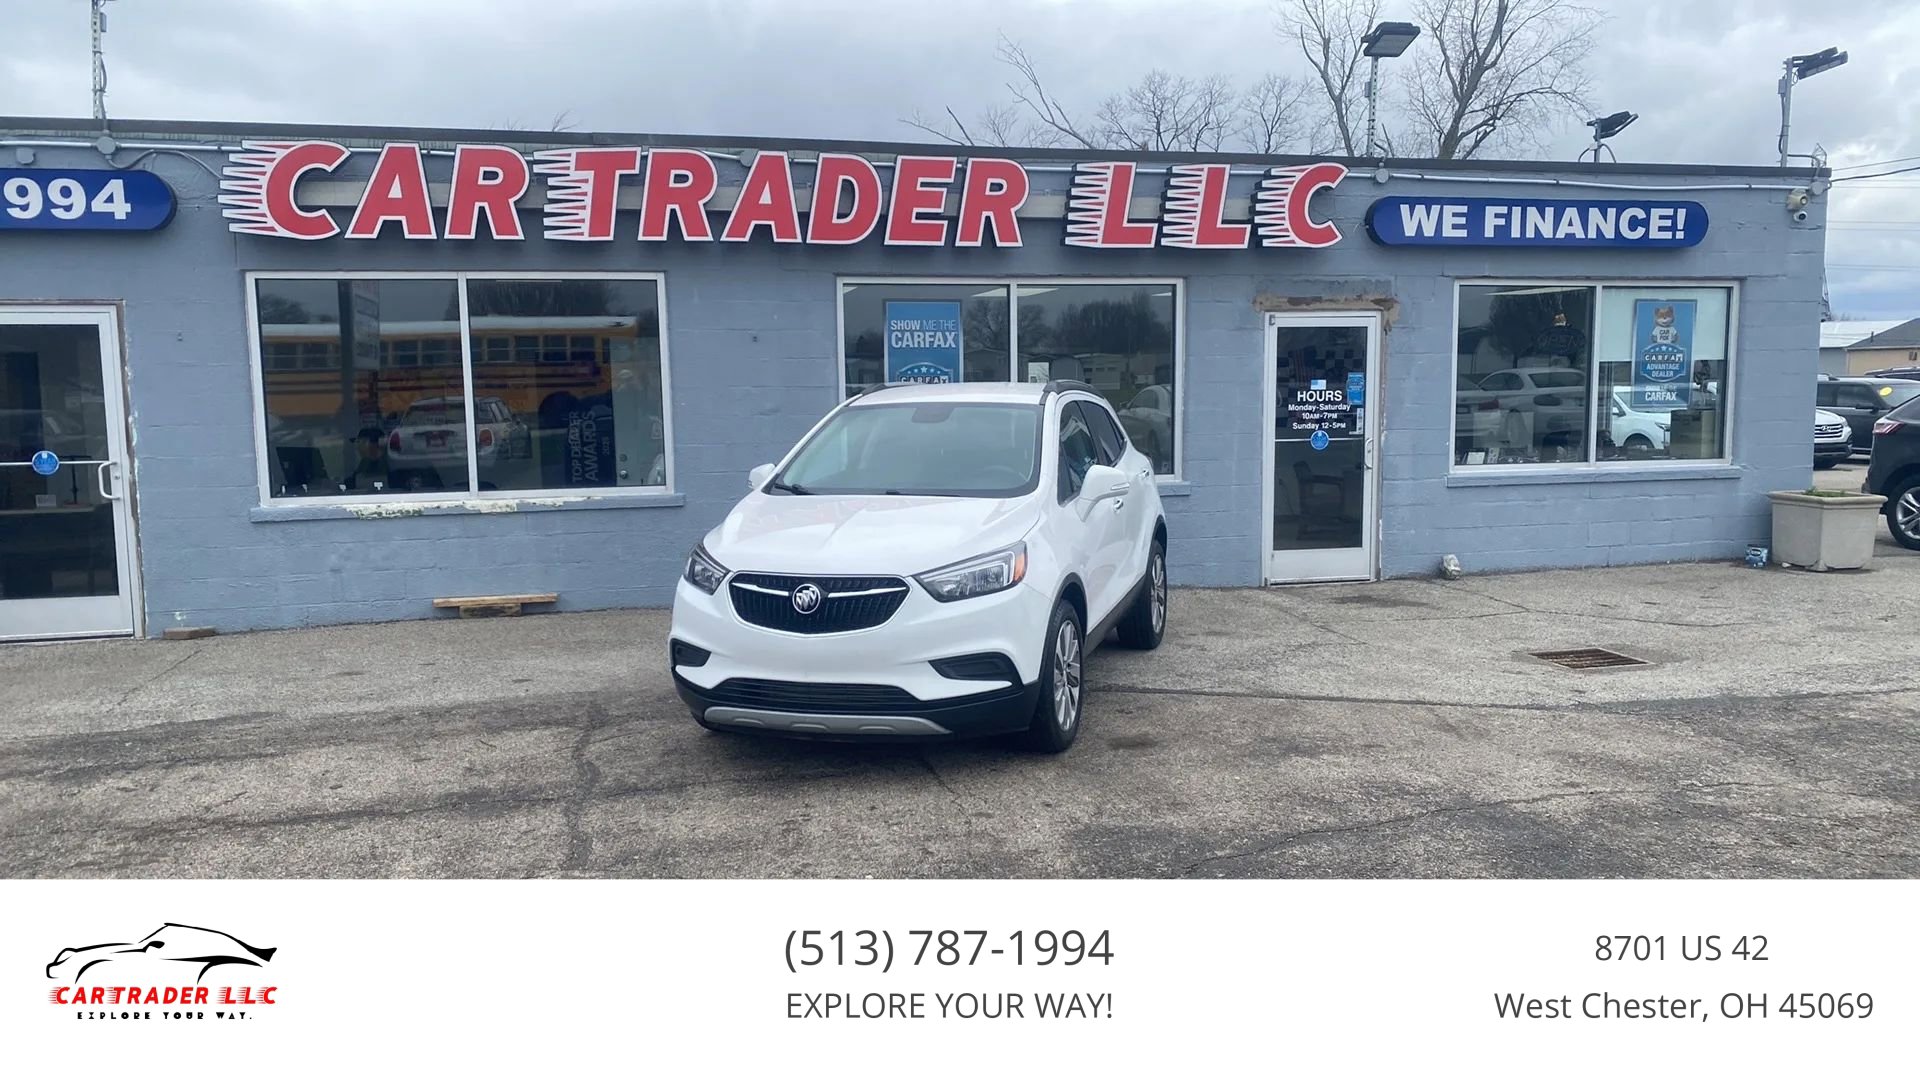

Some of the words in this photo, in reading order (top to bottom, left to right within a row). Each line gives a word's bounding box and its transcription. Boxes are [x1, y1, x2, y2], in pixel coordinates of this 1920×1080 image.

[4, 177, 132, 220] 994
[1064, 162, 1348, 250] LLC
[1400, 205, 1467, 238] WE
[1485, 205, 1687, 240] FINANCE!
[890, 319, 921, 331] SHOW
[923, 320, 937, 330] ME
[940, 320, 957, 330] THE
[891, 331, 957, 349] CARFAX
[1646, 363, 1680, 371] ADVANTAGE
[900, 375, 949, 384] CARFAX
[1297, 390, 1343, 402] HOURS
[1645, 391, 1678, 401] CARFAX
[1292, 422, 1320, 430] Sunday
[581, 411, 599, 482] AWARDS
[571, 459, 583, 483] TOP
